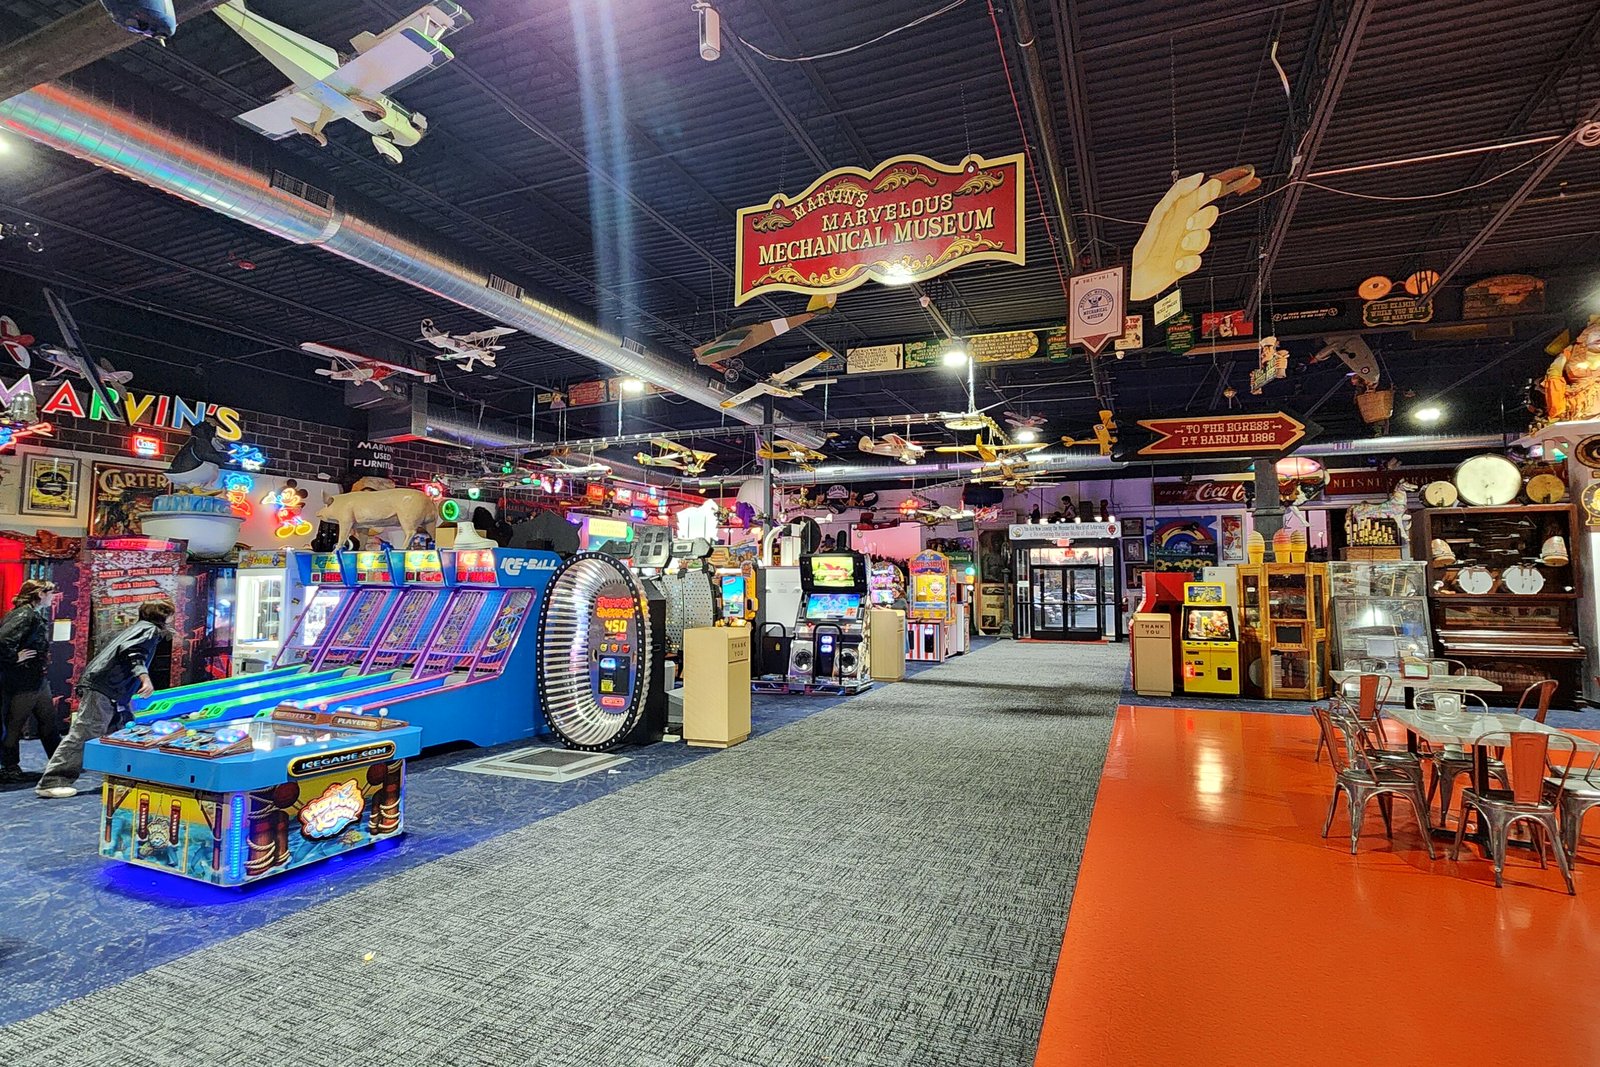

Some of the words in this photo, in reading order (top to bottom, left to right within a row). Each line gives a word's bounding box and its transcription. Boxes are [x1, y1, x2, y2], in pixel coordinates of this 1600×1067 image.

[791, 189, 869, 221] MARVIN'S
[822, 193, 953, 232] MARVELOUS
[758, 230, 888, 266] MECHANICAL
[893, 206, 995, 244] MUSEUM
[0, 373, 242, 441] MARVIN'S
[1202, 423, 1224, 434] THE
[1181, 435, 1200, 446] P.T.
[1201, 433, 1250, 446] BARNUM
[1250, 432, 1276, 444] 1886
[373, 452, 391, 461] USED
[1195, 482, 1246, 502] Coca-C
[500, 557, 558, 575] ICE-BALL
[605, 619, 628, 633] 450
[731, 641, 747, 649] THANK
[337, 717, 368, 727] PLAYER
[301, 746, 387, 770] ICEGAME.COM
